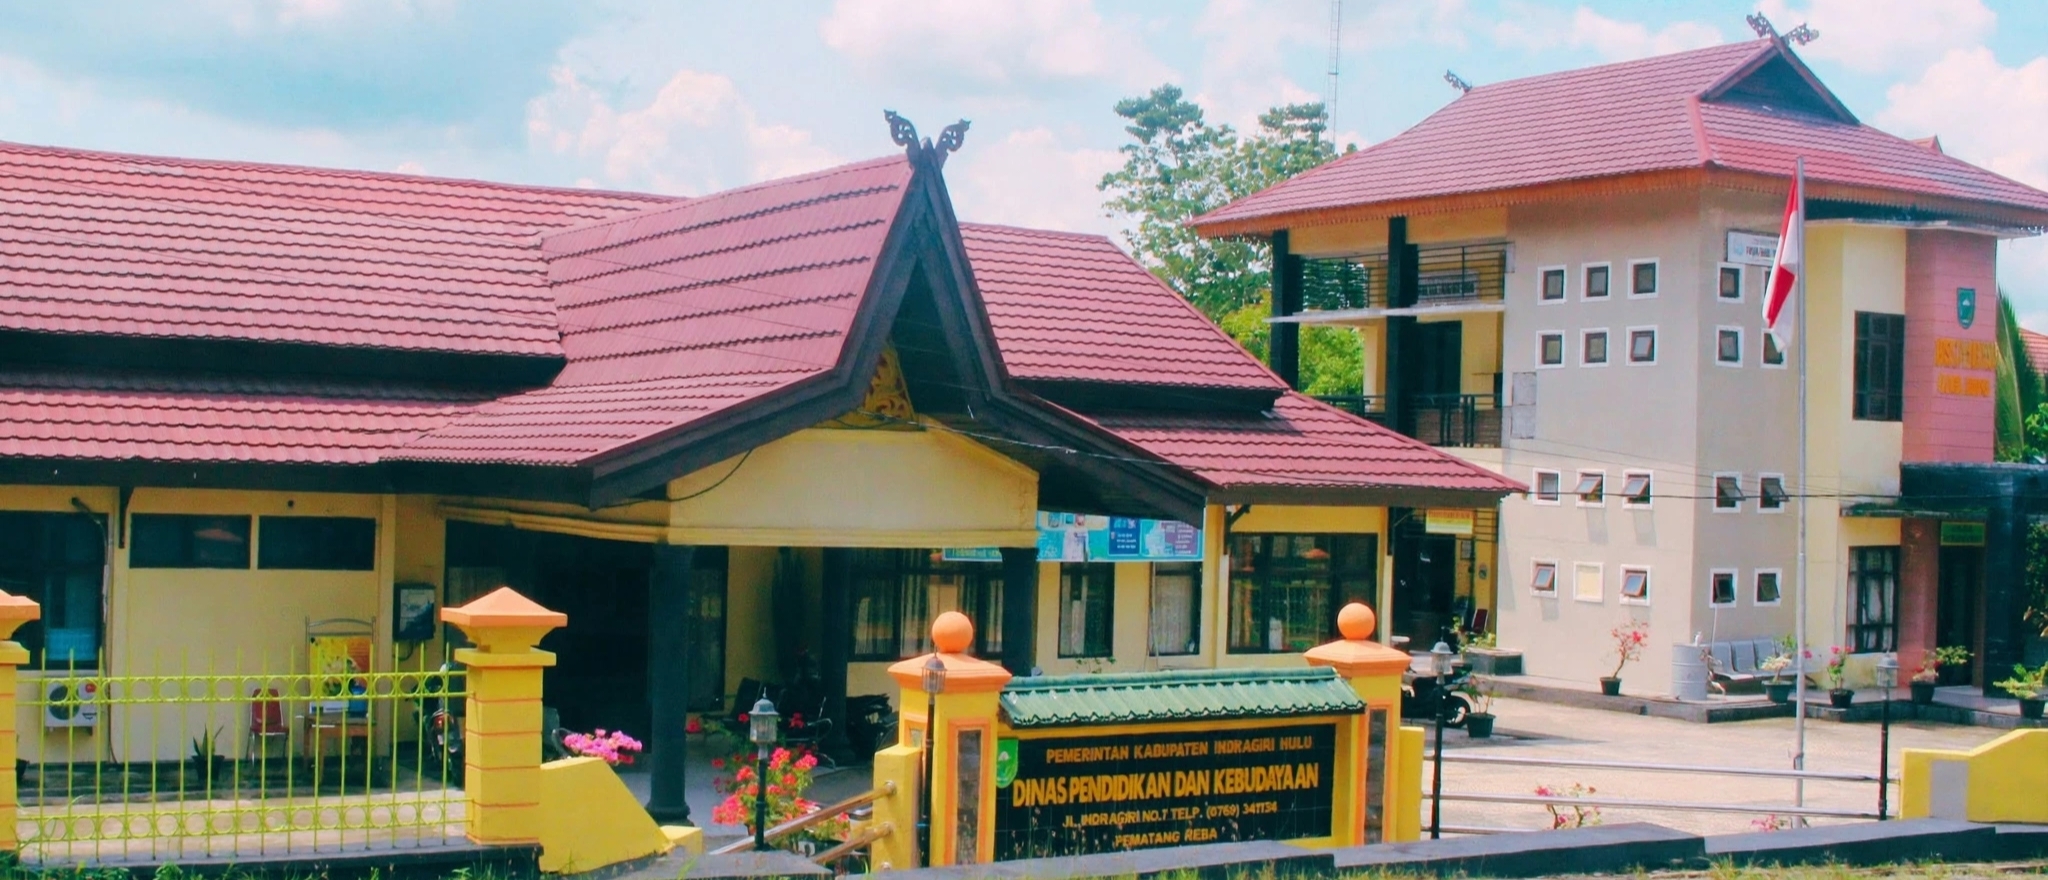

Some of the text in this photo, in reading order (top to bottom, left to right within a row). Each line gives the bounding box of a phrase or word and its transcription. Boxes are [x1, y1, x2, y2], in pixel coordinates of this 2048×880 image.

[1133, 741, 1209, 760] KABUPATEN
[1214, 736, 1275, 755] INDRAGIRI
[1280, 735, 1313, 751] HULU
[1012, 762, 1319, 808] DINAS PENDIDIKAN DAN KEBUDAYAAN
[1080, 809, 1140, 827] INDRAGIRI
[1141, 808, 1168, 823] NO.7
[1171, 805, 1203, 820] TELP.
[1206, 803, 1240, 820] (0769)
[1114, 827, 1218, 848] PEMATANG REBA
